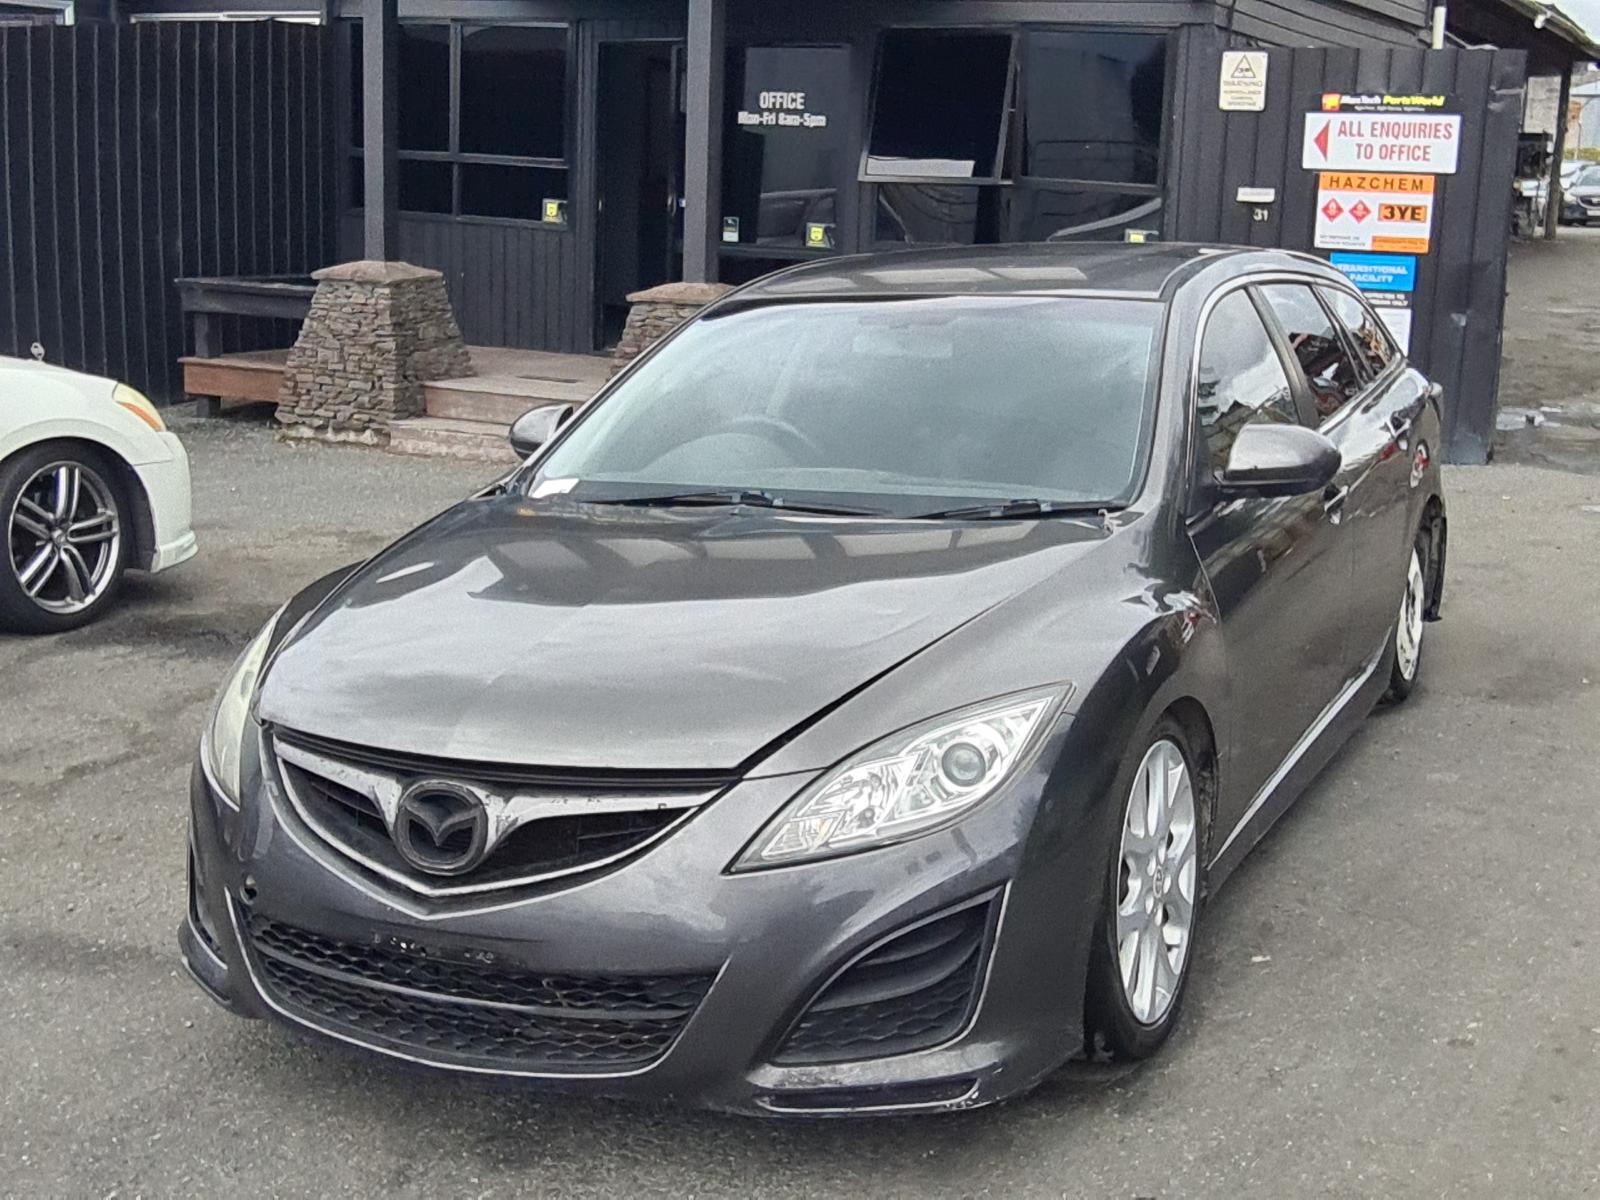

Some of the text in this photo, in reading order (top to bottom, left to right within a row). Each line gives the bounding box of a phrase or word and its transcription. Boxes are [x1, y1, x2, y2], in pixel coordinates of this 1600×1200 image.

[759, 91, 805, 110] OFFICE
[737, 111, 776, 126] Mon-Fri
[1337, 120, 1454, 141] ALL ENQUIRIES
[1355, 143, 1432, 162] TO OFFICE
[1329, 176, 1424, 191] HAZCHEM
[1253, 208, 1269, 222] 31
[1383, 205, 1423, 221] 3YE
